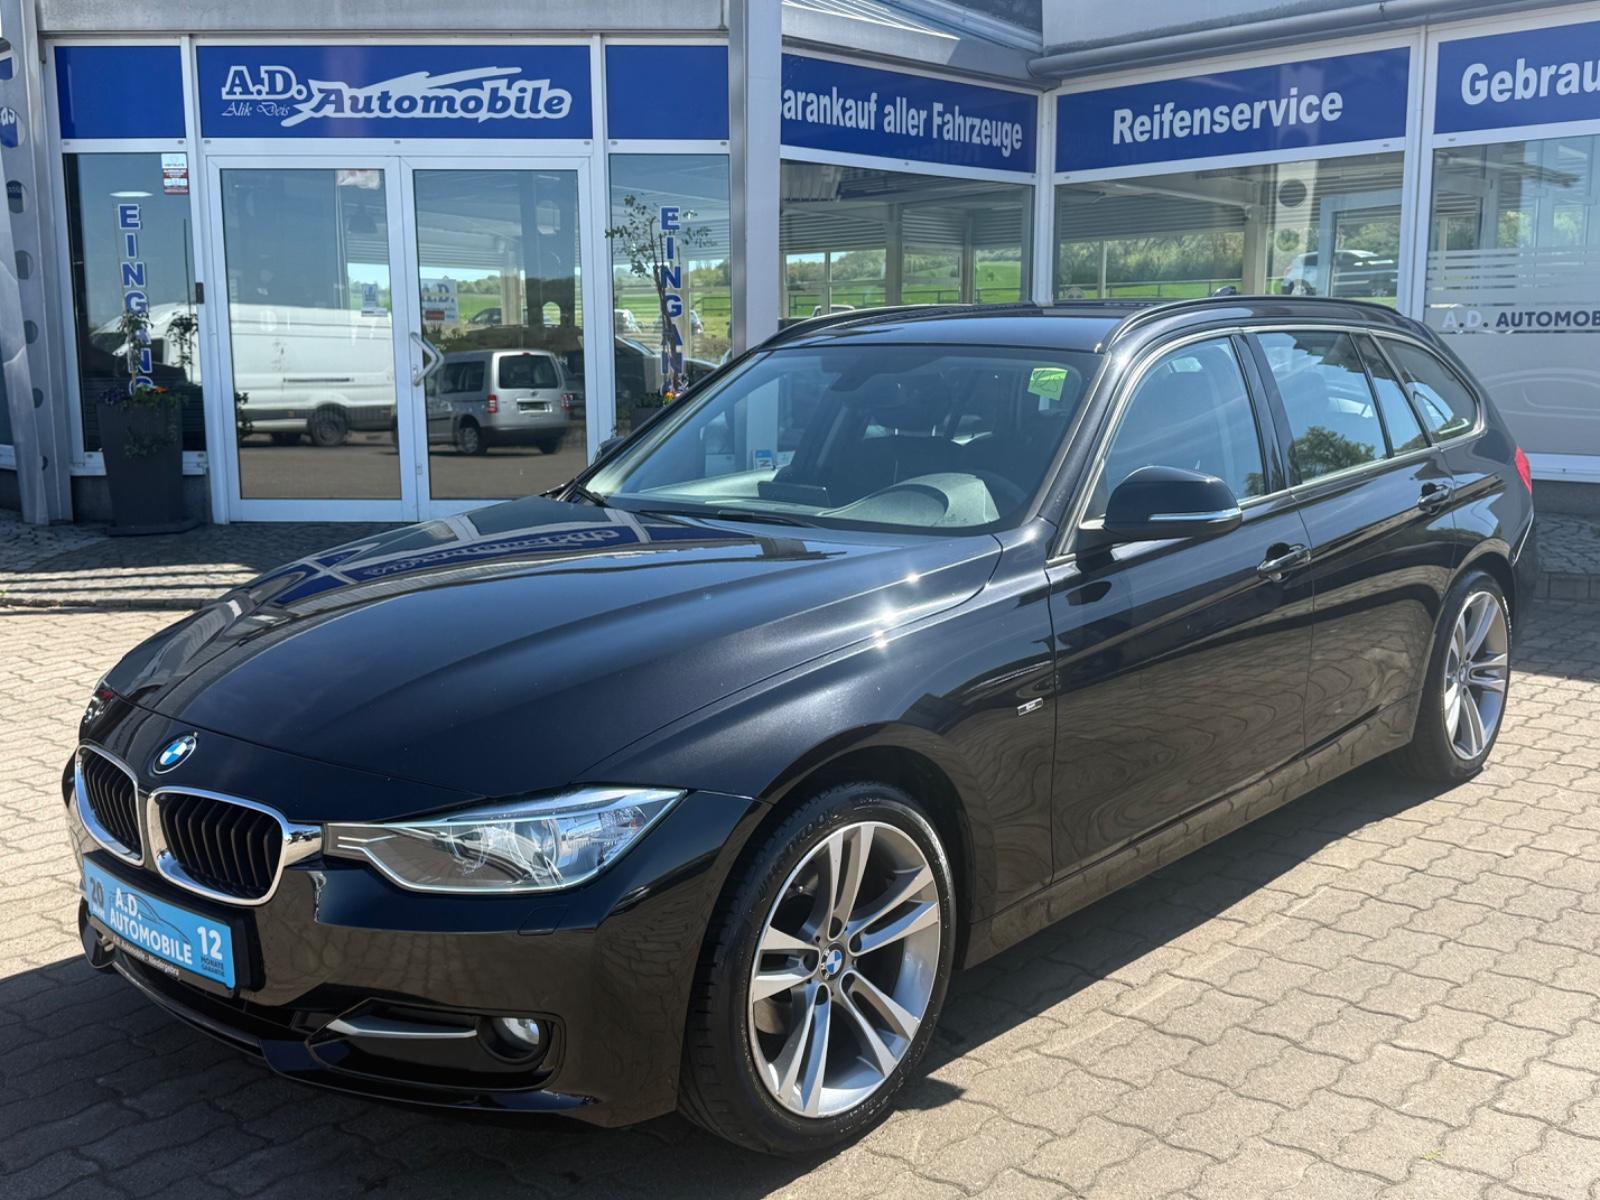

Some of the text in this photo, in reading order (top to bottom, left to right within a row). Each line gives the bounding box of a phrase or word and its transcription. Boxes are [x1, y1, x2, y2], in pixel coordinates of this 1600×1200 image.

[221, 65, 572, 121] A.D. Automobile
[781, 87, 878, 131] arankauf
[883, 97, 928, 137] aller
[932, 102, 1023, 158] Fahrzeuge
[1113, 87, 1343, 145] Reifenservice
[1442, 310, 1489, 328] A.D.
[90, 876, 104, 909] 20
[116, 887, 142, 920] A.D.
[110, 907, 193, 966] AUTOMOBILE
[197, 926, 222, 960] 12
